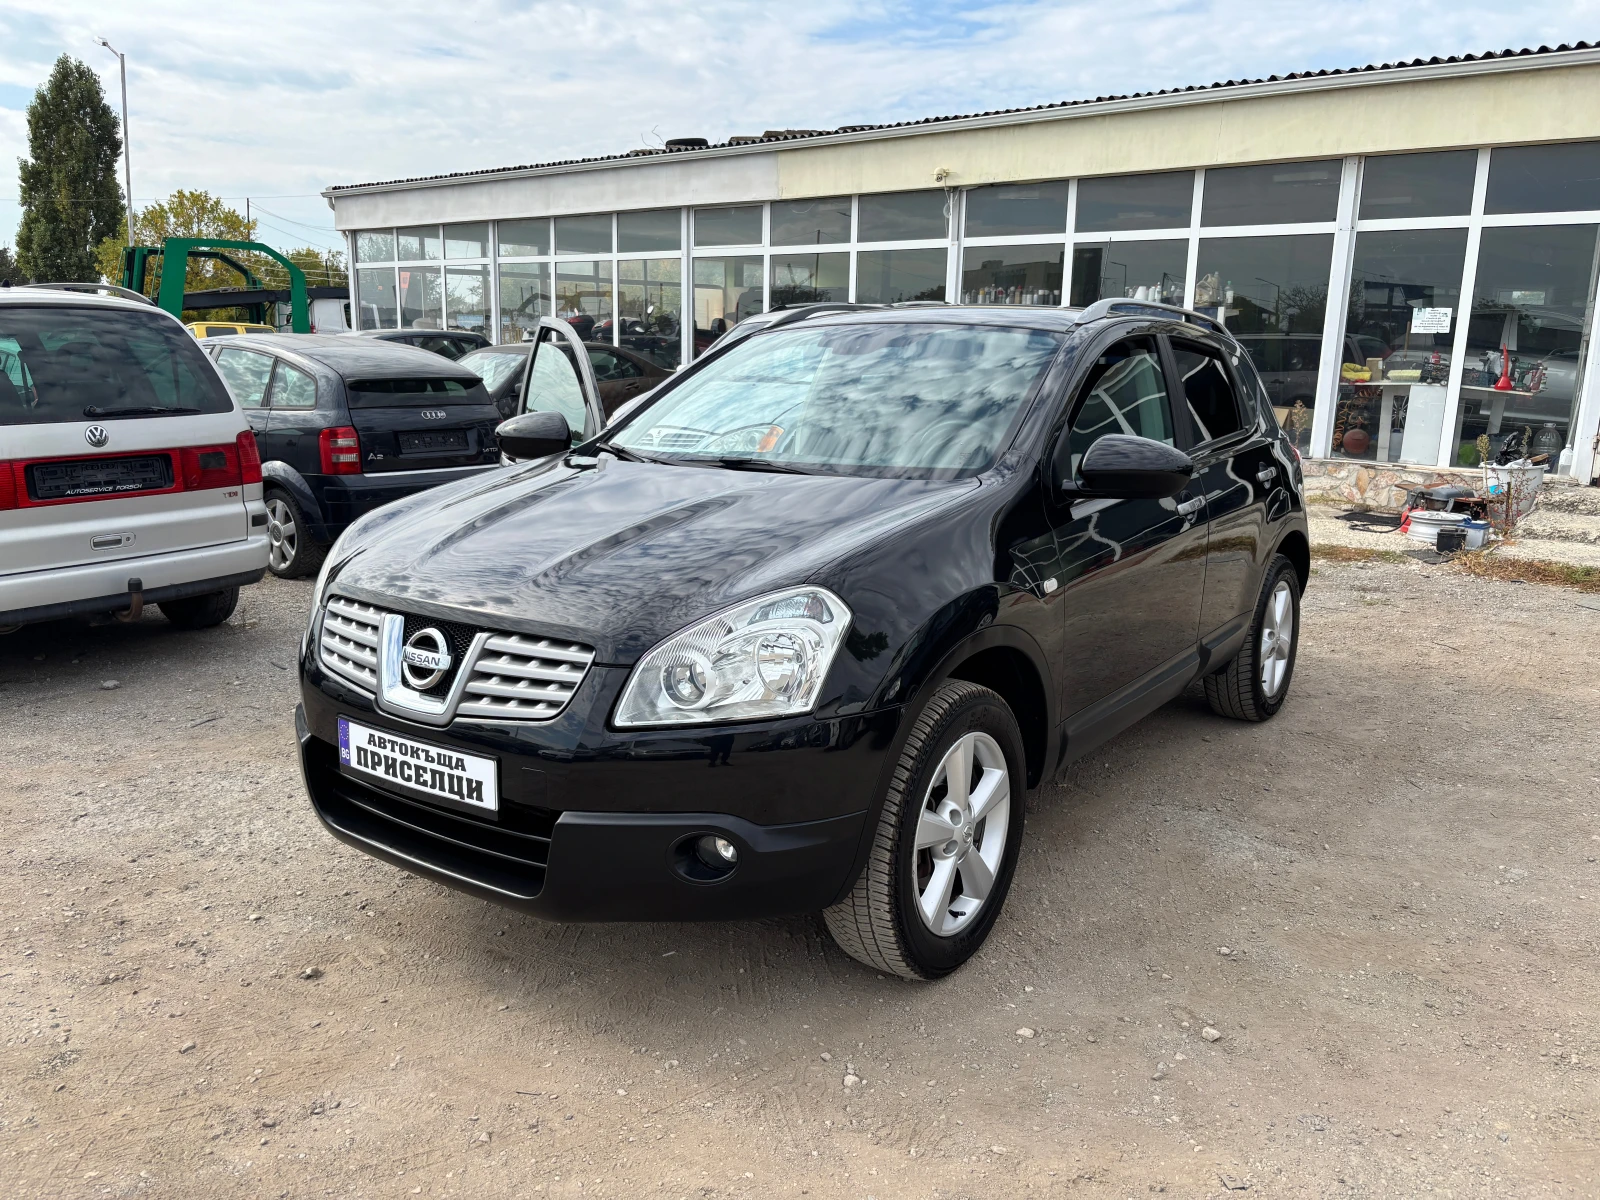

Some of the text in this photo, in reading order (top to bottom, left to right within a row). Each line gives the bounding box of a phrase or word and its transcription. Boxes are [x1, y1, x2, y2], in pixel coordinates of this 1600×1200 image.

[65, 486, 113, 495] AUTOSERVICE
[402, 648, 440, 666] NISSAN
[341, 747, 350, 760] BG
[367, 733, 467, 772] АВТОКЪЩА
[356, 745, 484, 802] ПРИСЕЛЦИ
